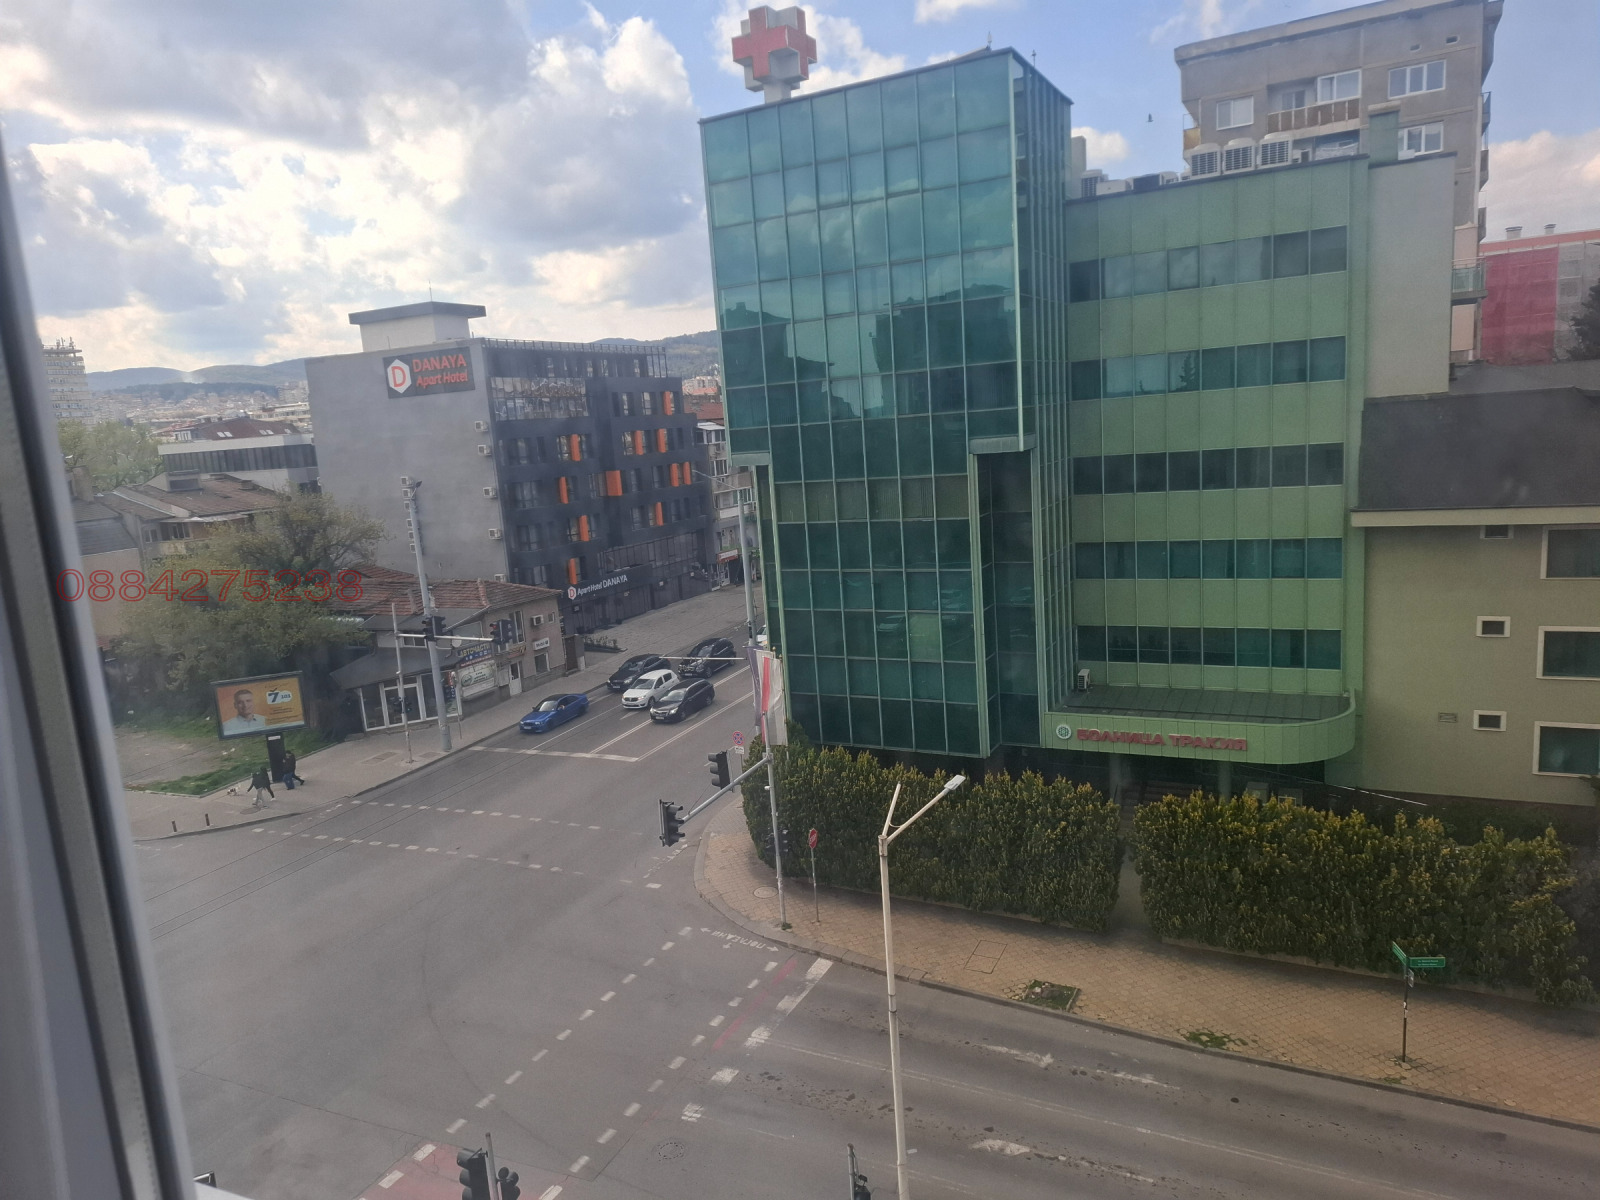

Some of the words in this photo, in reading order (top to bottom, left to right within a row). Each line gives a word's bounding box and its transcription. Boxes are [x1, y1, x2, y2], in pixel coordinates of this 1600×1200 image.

[412, 354, 467, 373] DANAYA
[391, 365, 407, 388] D
[416, 374, 442, 389] Apart
[443, 370, 468, 384] Hotel
[577, 586, 591, 597] Apart
[590, 581, 603, 592] Hotel
[602, 574, 628, 588] DANAYA
[268, 691, 280, 703] 7
[1076, 728, 1166, 746] БОЛНИЦА
[1168, 733, 1248, 751] ТРАКИЯ
